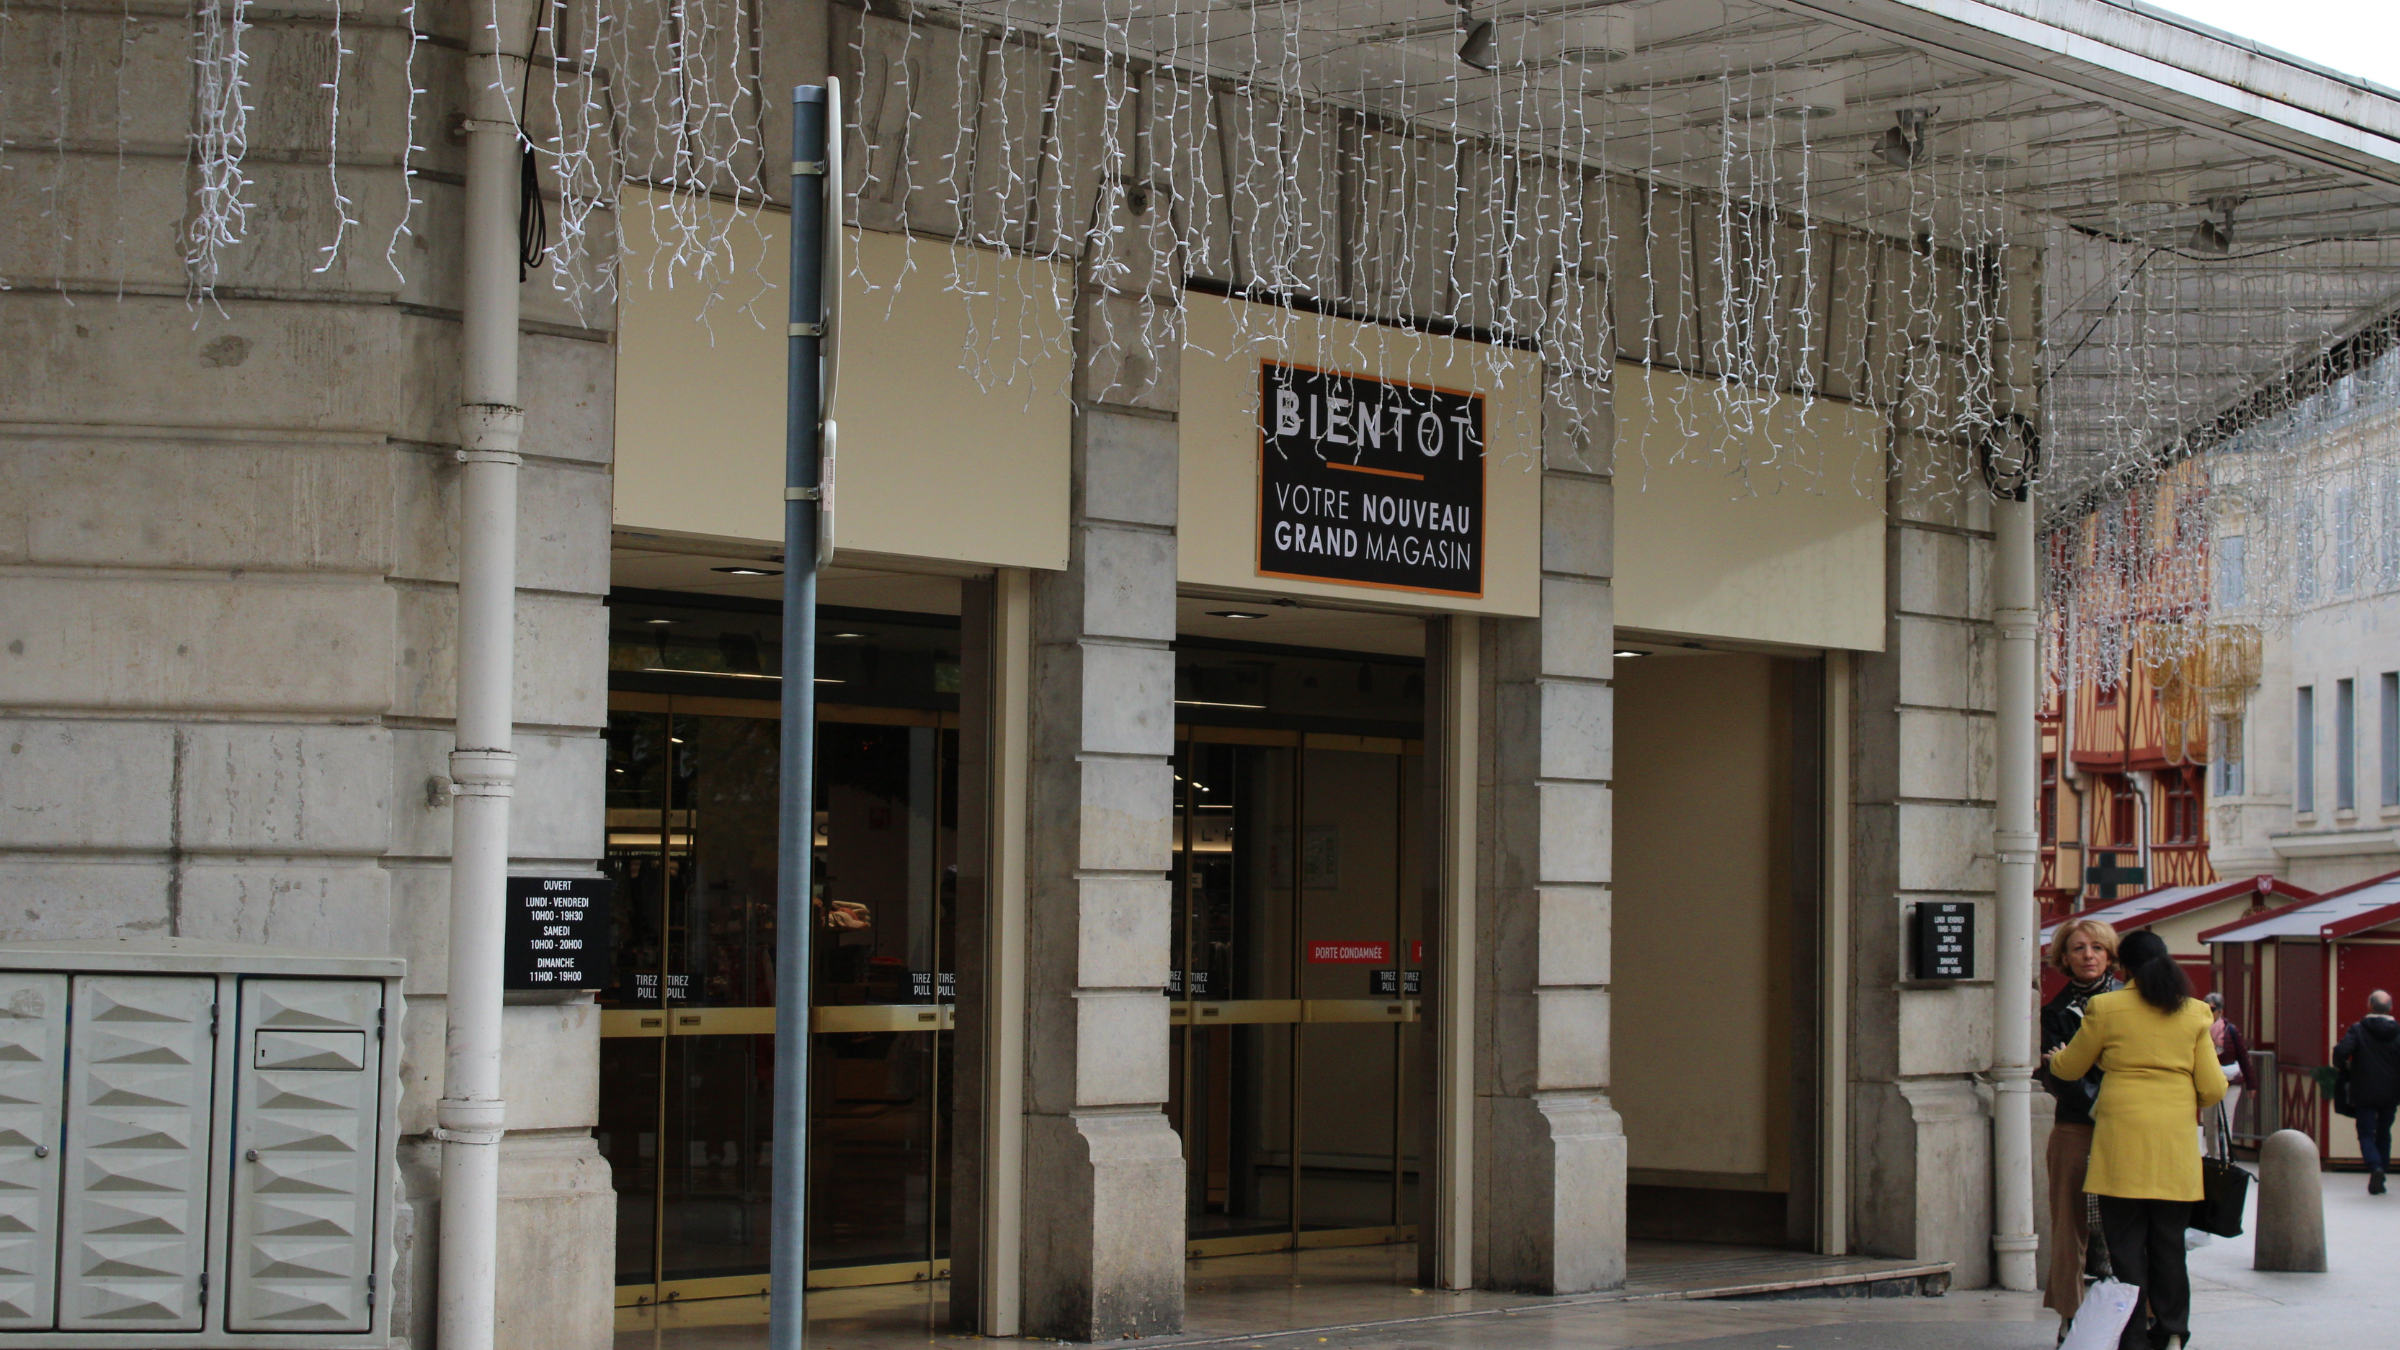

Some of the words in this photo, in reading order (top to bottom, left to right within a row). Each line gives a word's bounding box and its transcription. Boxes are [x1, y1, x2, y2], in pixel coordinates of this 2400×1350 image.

[1276, 388, 1471, 462] BIENTOT
[1276, 482, 1349, 519] VOTRE
[1364, 494, 1469, 535] NOUVEAU
[1275, 521, 1357, 557] GRAND
[1366, 531, 1470, 570] MAGASIN
[544, 881, 571, 890] OUVERT
[526, 897, 547, 907] LUNDI
[554, 897, 588, 907] VENDREDI
[532, 911, 554, 920] 10H00
[561, 911, 583, 920] 19H30
[544, 926, 570, 935] SAMEDI
[531, 940, 553, 949] 10H00
[560, 940, 582, 949] 20H00
[1316, 947, 1337, 958] PORTE
[1340, 946, 1382, 958] CONDAMNÉE
[538, 958, 574, 967] DIMANCHE
[530, 972, 552, 981] 11H00
[560, 971, 581, 981] 19H00
[636, 975, 657, 985] TIREZ
[666, 975, 689, 986] TIREZ
[912, 974, 930, 983] TIREZ
[1190, 972, 1207, 981] TIREZ
[1381, 972, 1395, 980] TIREZ
[1403, 972, 1419, 981] TIREZ
[914, 986, 930, 995] PULL
[1190, 983, 1205, 994] PULL
[1382, 982, 1395, 991] PULL
[1403, 982, 1417, 992] PULL
[638, 988, 657, 998] PULL
[666, 987, 686, 998] PULL
